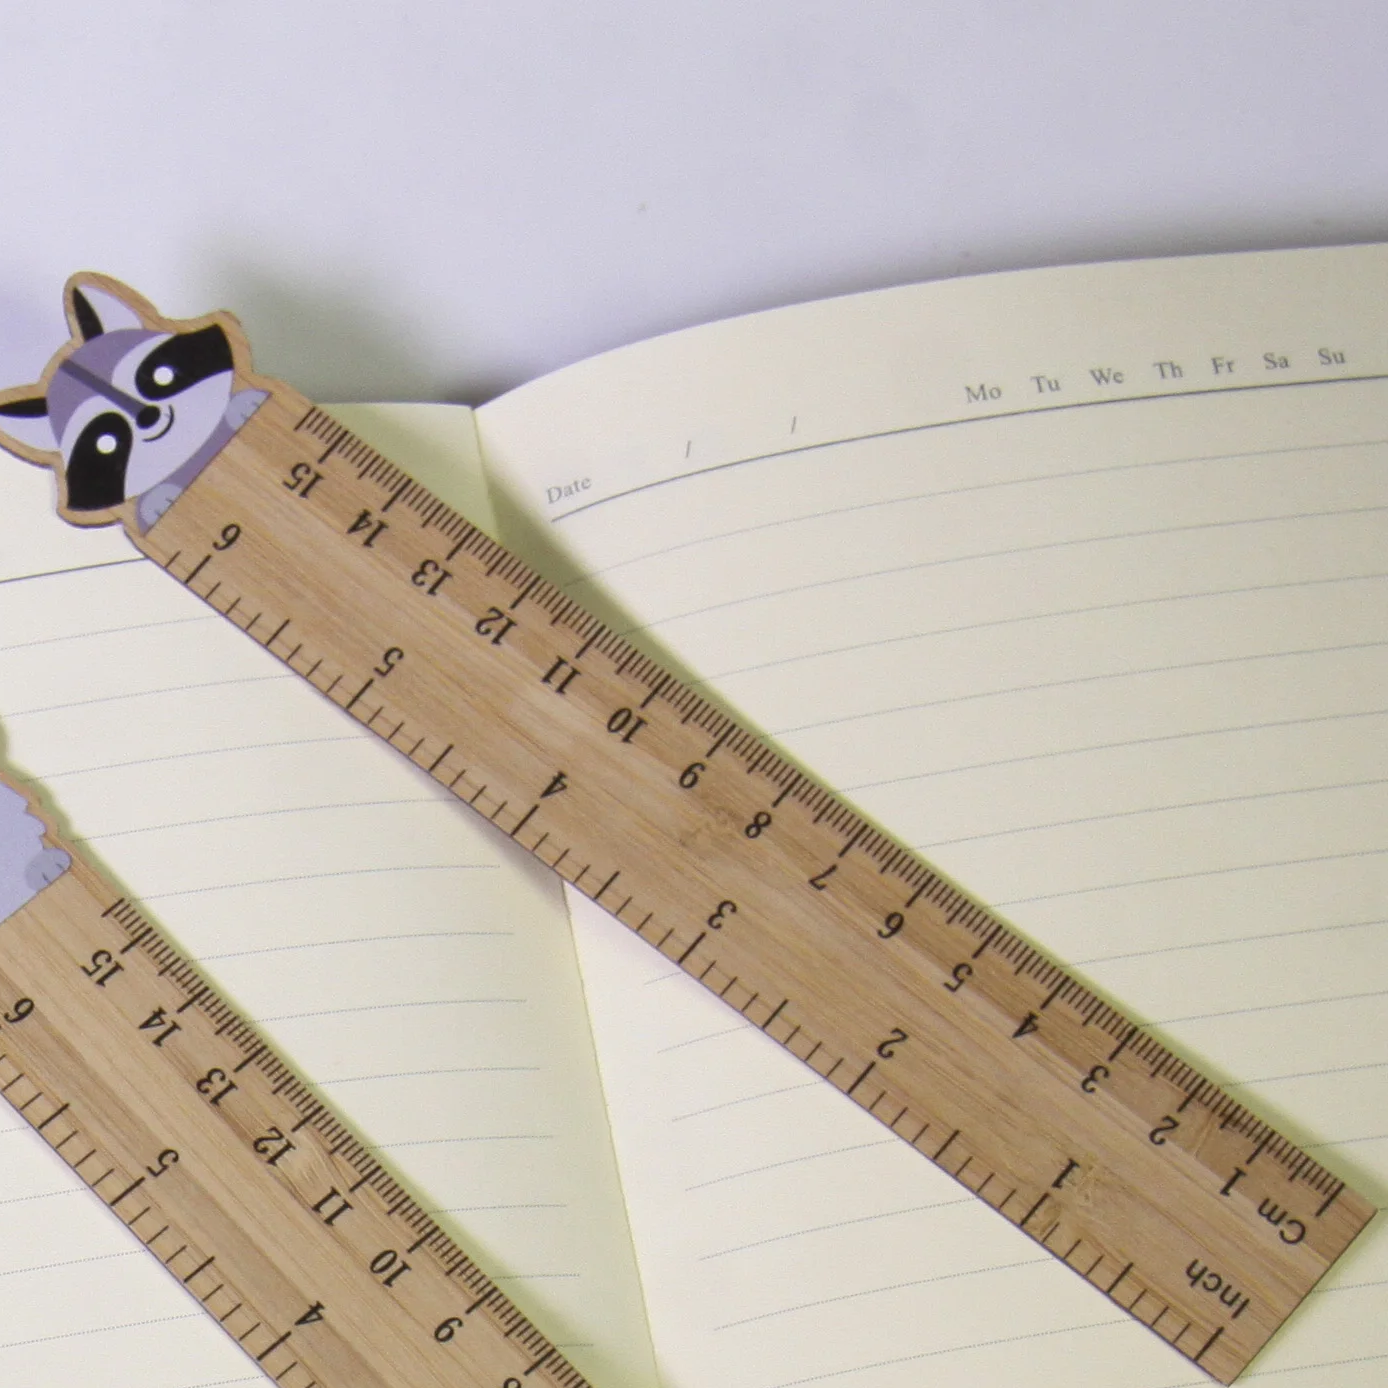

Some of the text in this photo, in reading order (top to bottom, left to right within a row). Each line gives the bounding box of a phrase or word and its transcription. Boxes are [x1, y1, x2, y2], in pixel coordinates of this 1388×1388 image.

[964, 348, 1346, 403] Mo Tu We Th Fr Sa Su
[546, 476, 592, 504] Date
[283, 463, 1309, 1246] Cm 1 2 3 4 5 6 7 8 9 10 11 12 13 14 15
[213, 524, 1251, 1321] Inch 1 2 3 4 5 6
[80, 950, 124, 987] 15
[3, 997, 35, 1024] 6
[138, 1006, 181, 1047] 14
[196, 1068, 238, 1107] 13
[146, 1149, 179, 1178] 5
[252, 1126, 296, 1167] 12
[309, 1186, 354, 1227] 11
[369, 1249, 412, 1287] 10
[294, 1301, 325, 1326] 4
[434, 1317, 463, 1343] 9
